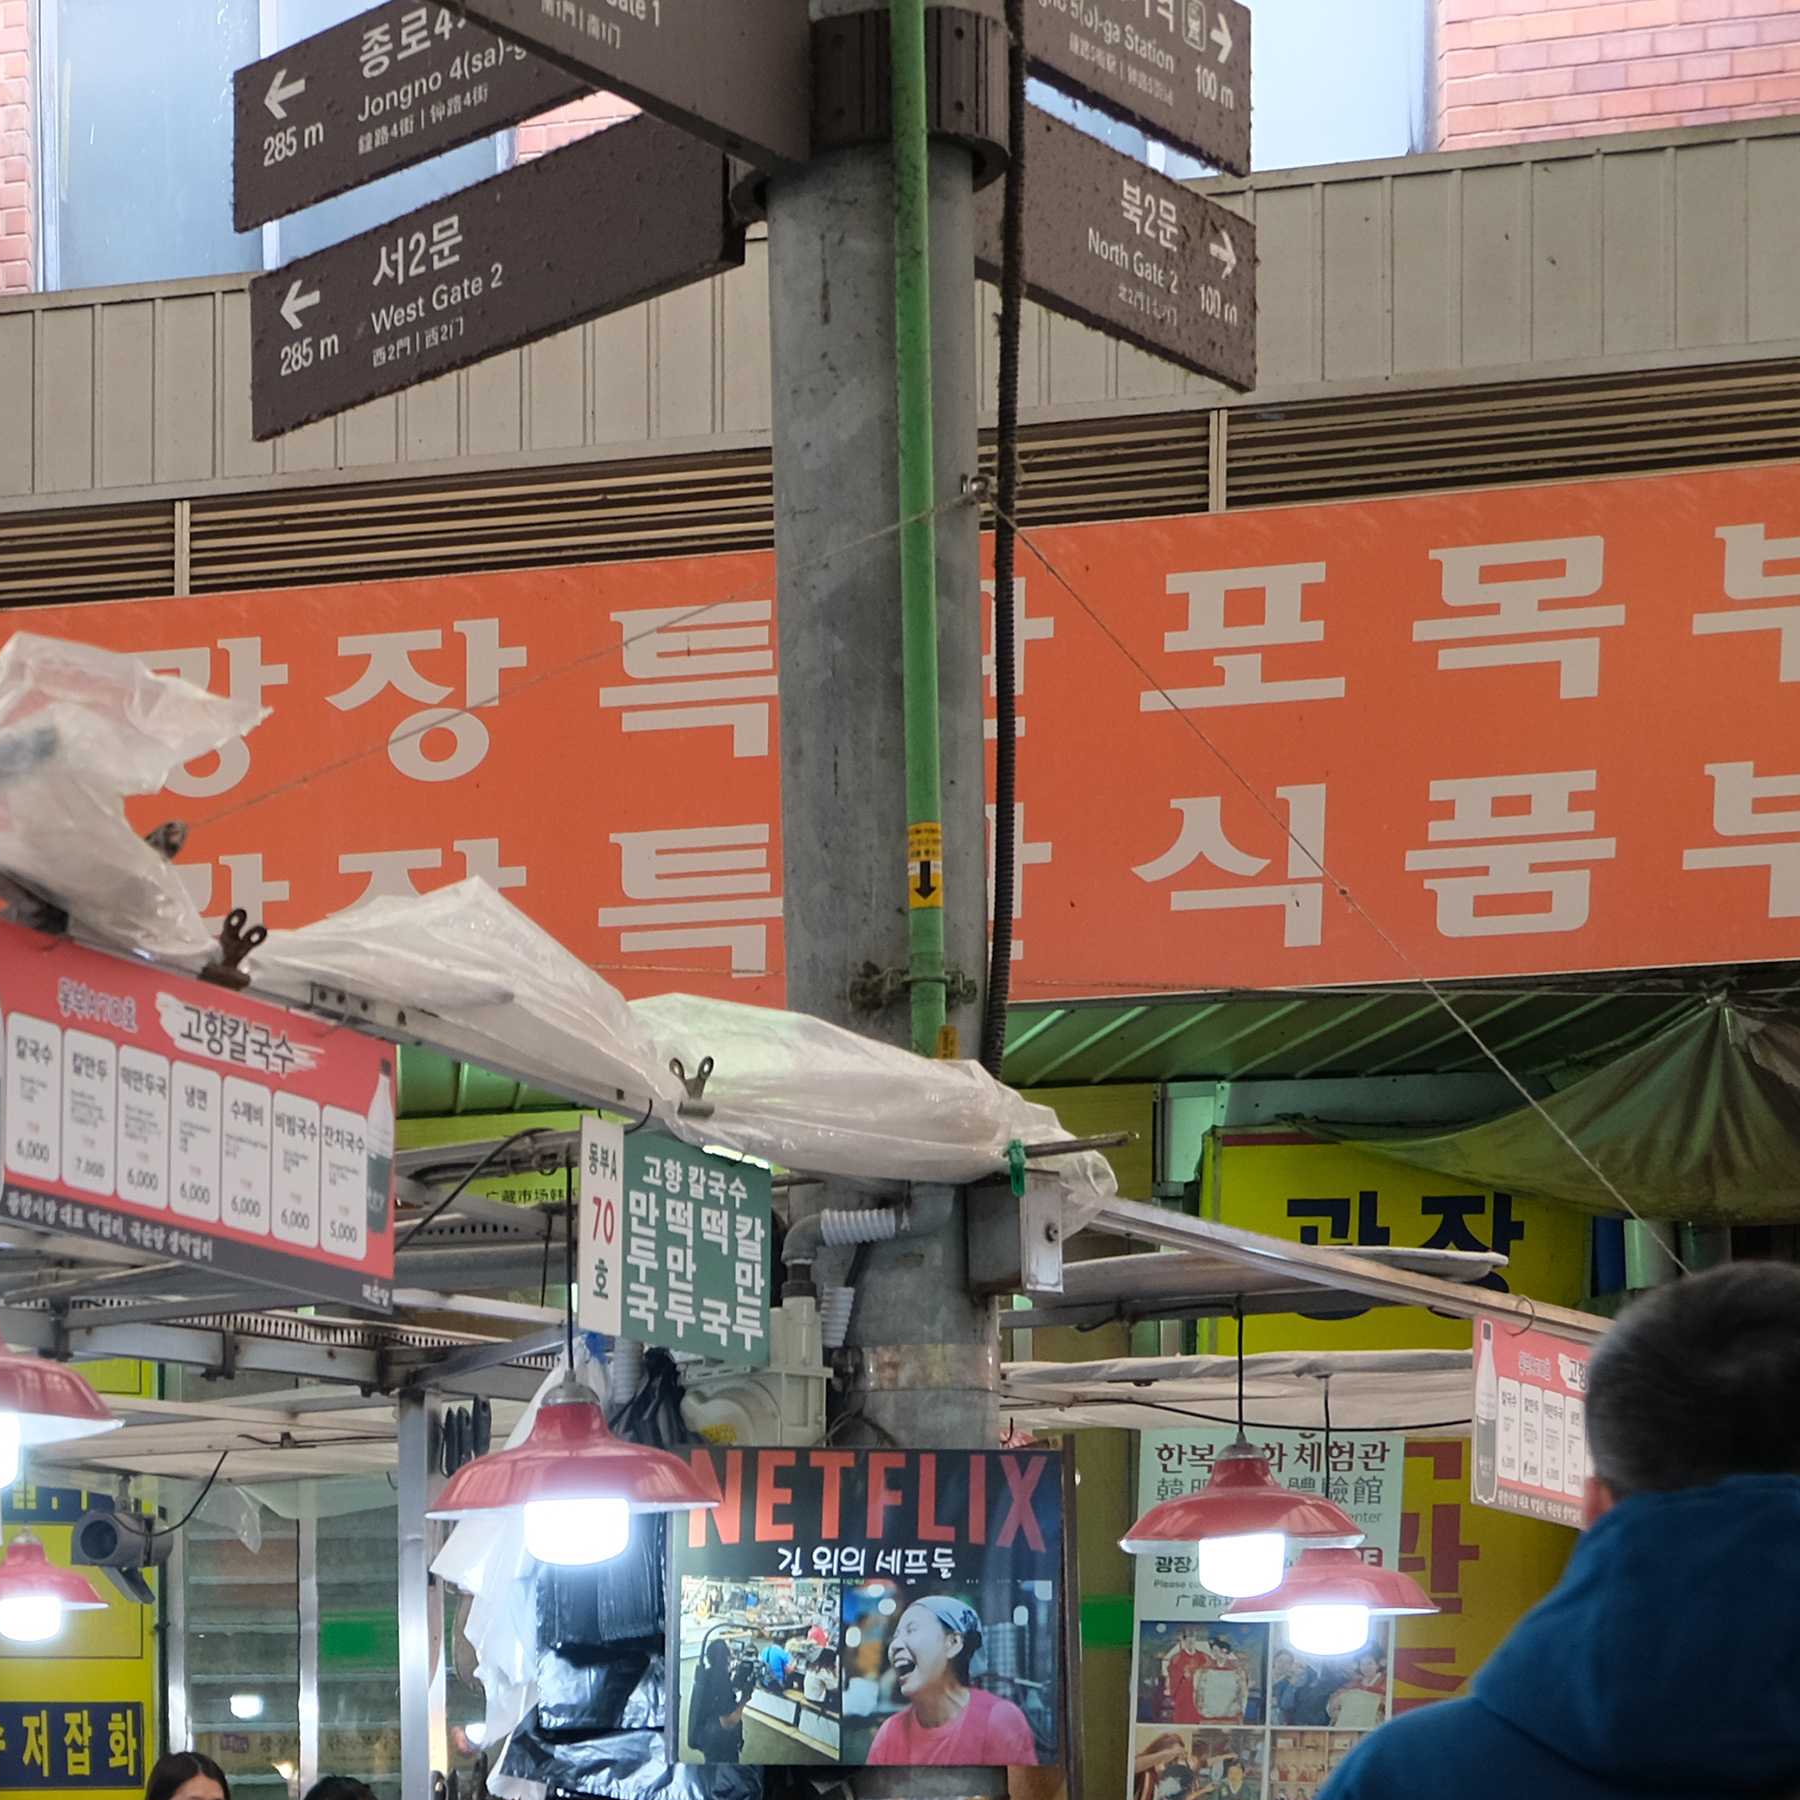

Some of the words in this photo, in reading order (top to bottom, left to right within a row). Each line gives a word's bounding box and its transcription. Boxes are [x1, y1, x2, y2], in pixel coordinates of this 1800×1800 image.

[359, 8, 466, 79] 종로4
[1124, 24, 1175, 74] Station
[358, 71, 441, 122] Jongno
[1195, 64, 1218, 102] 100
[1220, 84, 1235, 110] m
[263, 131, 298, 167] 285
[302, 118, 324, 147] m
[1122, 178, 1179, 253] 북2문
[371, 215, 463, 287] 서2문
[1087, 227, 1129, 271] North
[1133, 248, 1165, 287] Gate
[1169, 270, 1180, 295] 2
[370, 295, 425, 335] West
[432, 273, 484, 313] Gate
[490, 262, 503, 289] 2
[1199, 285, 1221, 324] 100
[1223, 301, 1239, 326] m
[280, 342, 314, 376] 285
[317, 331, 339, 358] m
[16, 1035, 52, 1066] 칼국수
[180, 1005, 295, 1075] 고향칼국수
[16, 1139, 50, 1163] 6,000
[324, 1125, 365, 1154] 잔치국수
[127, 1169, 158, 1191] 6,000
[180, 1182, 210, 1205] 6,000
[643, 1156, 683, 1194] 고향
[688, 1165, 748, 1209] 칼국수
[231, 1196, 261, 1218] 6,000
[281, 1209, 310, 1230] 6,000
[593, 1196, 615, 1245] 70
[330, 1221, 358, 1243] 5,000
[593, 1258, 609, 1300] 호
[627, 1190, 659, 1333] 만두국
[664, 1198, 696, 1338] 떡만두
[732, 1214, 765, 1350] 칼만두
[689, 1450, 1047, 1553] NETFLIX
[778, 1547, 803, 1576] 길
[812, 1547, 866, 1576] 위의
